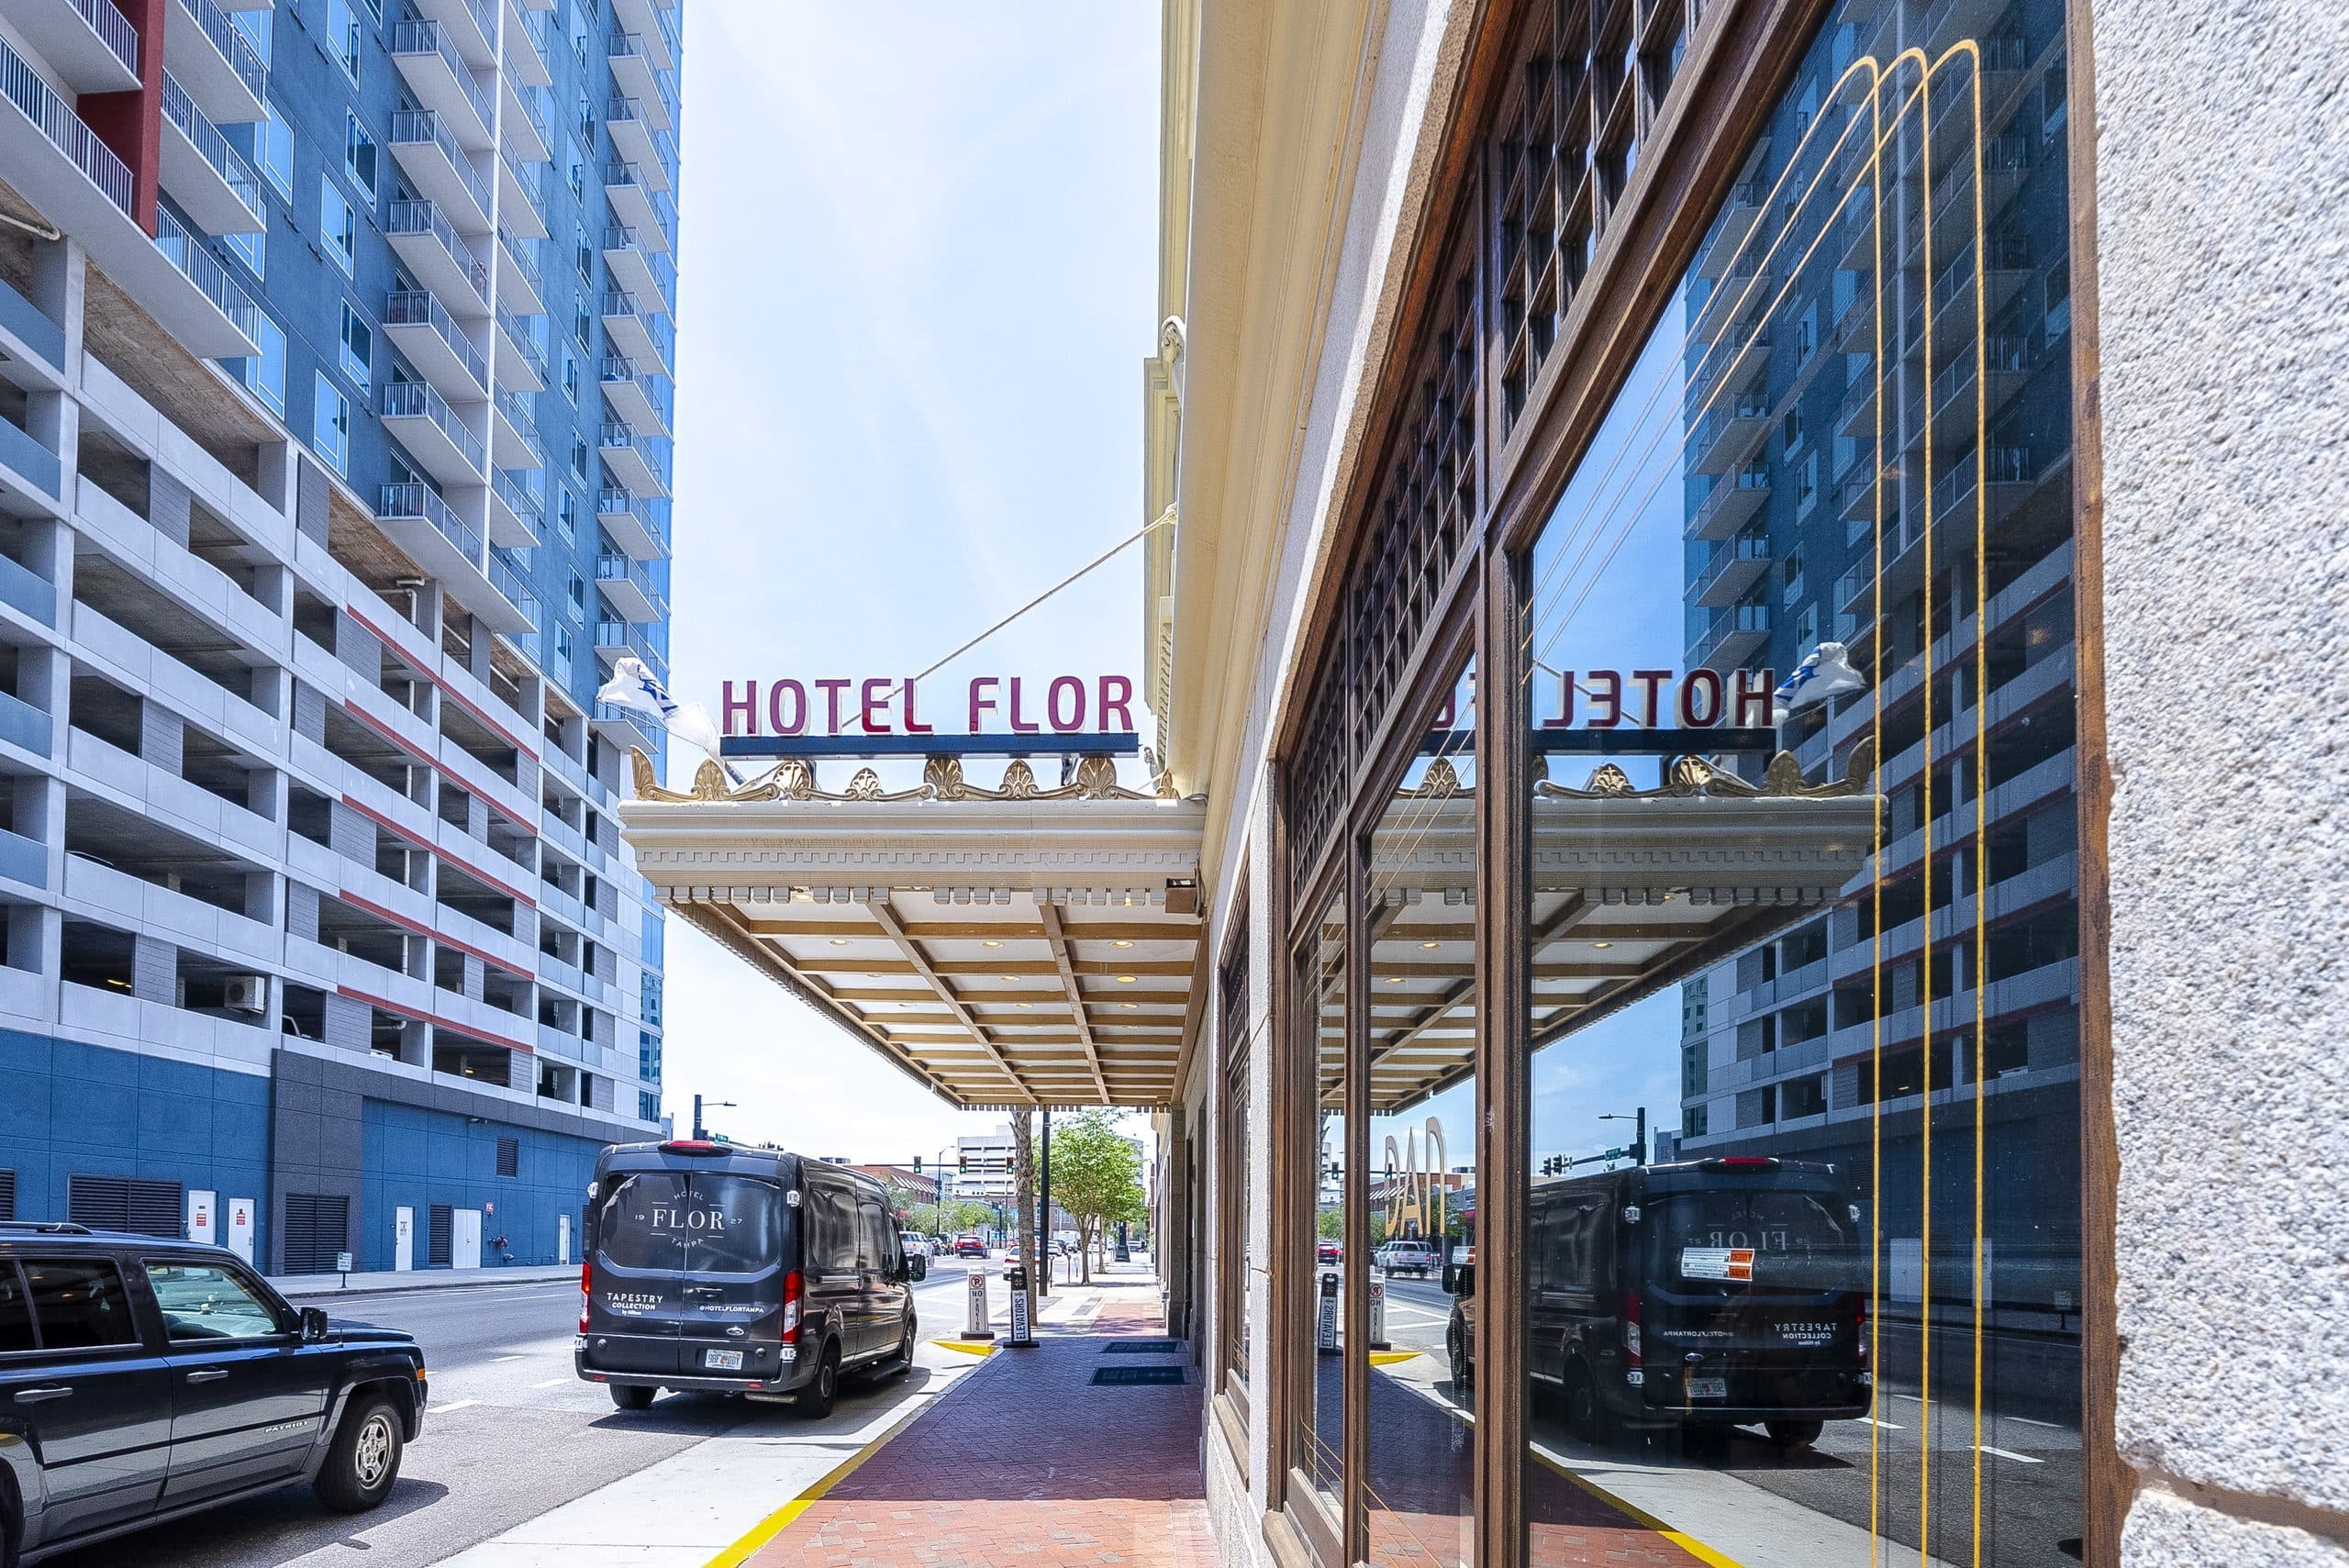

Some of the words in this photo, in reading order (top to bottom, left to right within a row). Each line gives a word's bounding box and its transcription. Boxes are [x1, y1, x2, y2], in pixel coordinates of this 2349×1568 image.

[722, 677, 933, 735] HOTEL
[969, 675, 1134, 734] FLOR
[674, 1190, 704, 1201] HOTEL
[651, 1208, 725, 1230] FLOR
[671, 1237, 704, 1249] TAMPA
[607, 1292, 663, 1304] TAPESTRY
[612, 1302, 656, 1310] COLLECTION
[1015, 1298, 1026, 1340] ELEVATORS
